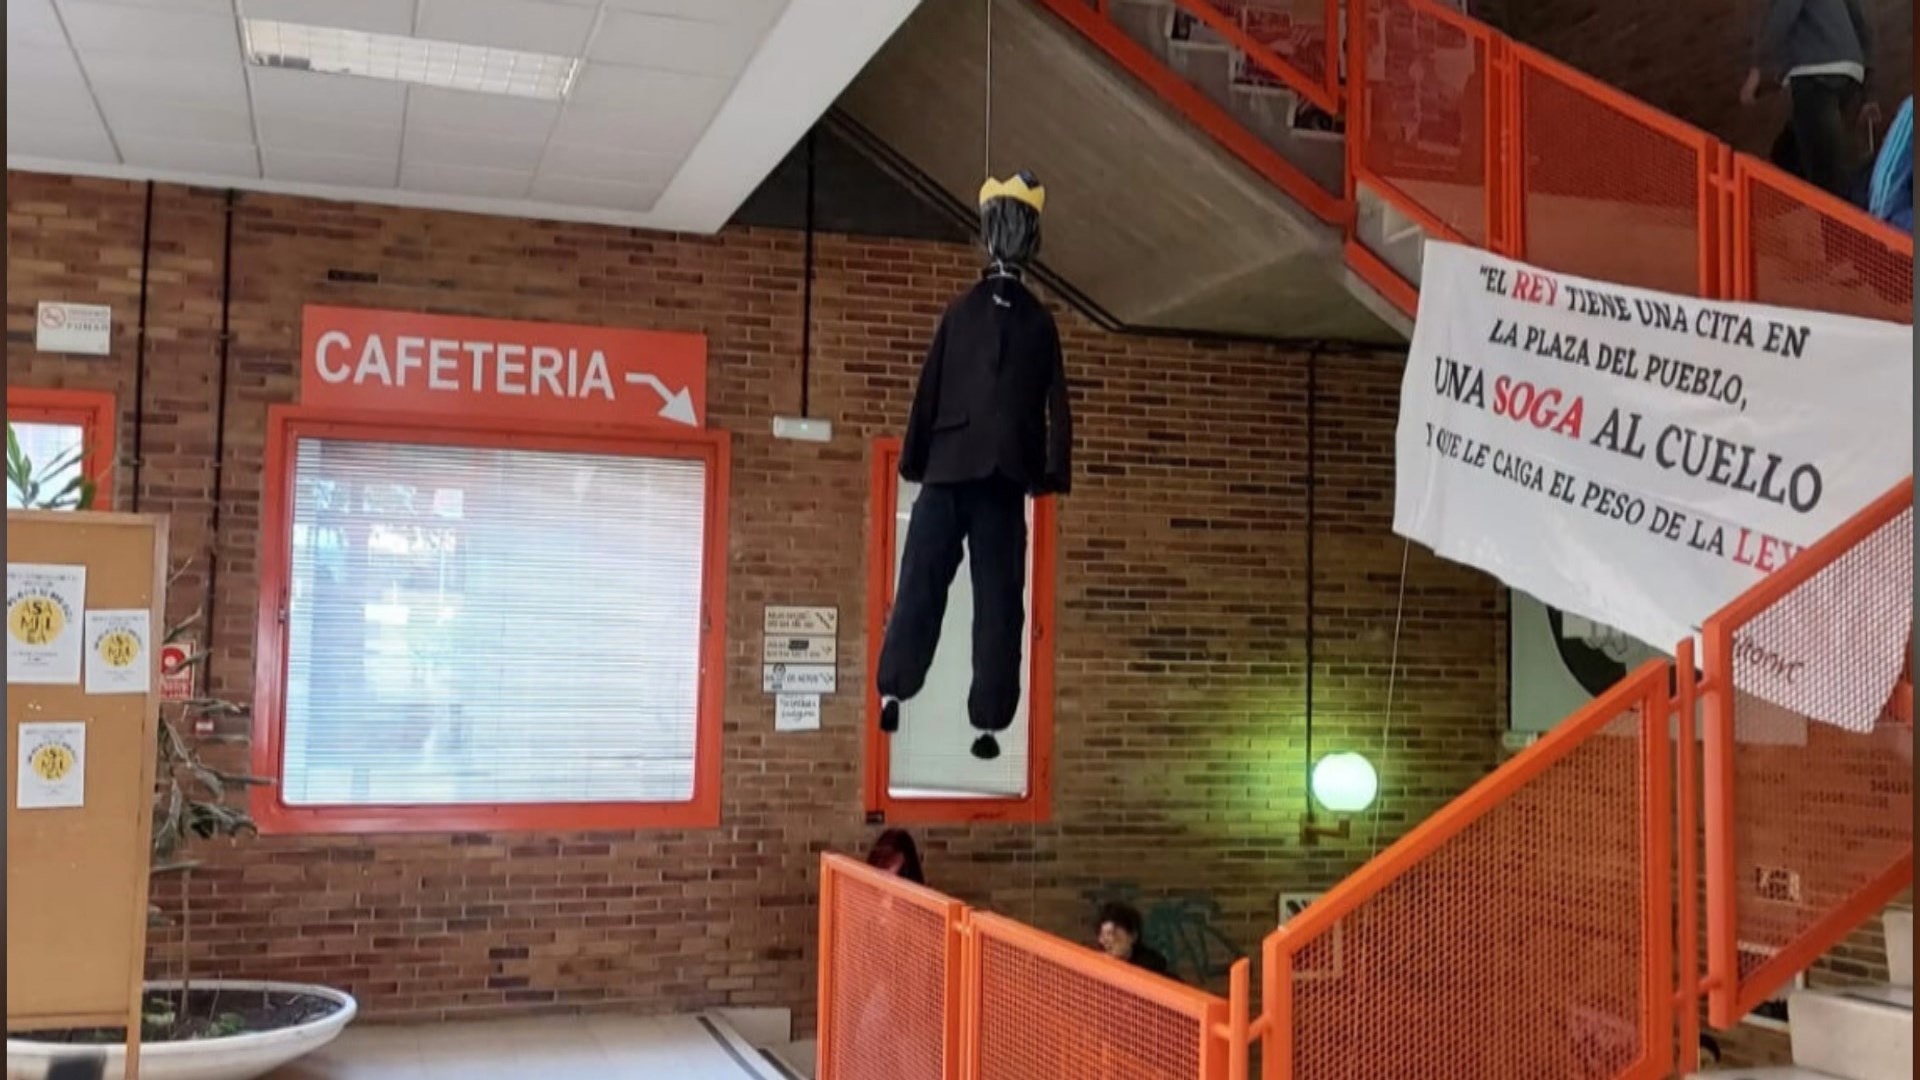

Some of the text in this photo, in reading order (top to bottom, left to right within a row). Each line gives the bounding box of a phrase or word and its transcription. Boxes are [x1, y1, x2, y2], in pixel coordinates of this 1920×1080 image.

[1511, 270, 1558, 307] REY
[1564, 285, 1632, 321] TIENE
[1635, 299, 1688, 333] UNA
[1695, 307, 1754, 347] CITA
[1762, 321, 1811, 358] EN
[315, 330, 616, 400] CAFETERIA
[1488, 318, 1748, 412] LA PLAZA DEL PUEBLO,
[1434, 356, 1823, 513] UNA SOGA AL CUELLO
[1426, 422, 1434, 447] Y
[1436, 427, 1462, 458] QUE
[1462, 439, 1490, 468] LE
[1492, 449, 1543, 492] CAIGA
[1549, 469, 1576, 504] EL
[1580, 480, 1646, 526] PESO
[1648, 505, 1686, 541] DE
[1687, 519, 1724, 557] LA
